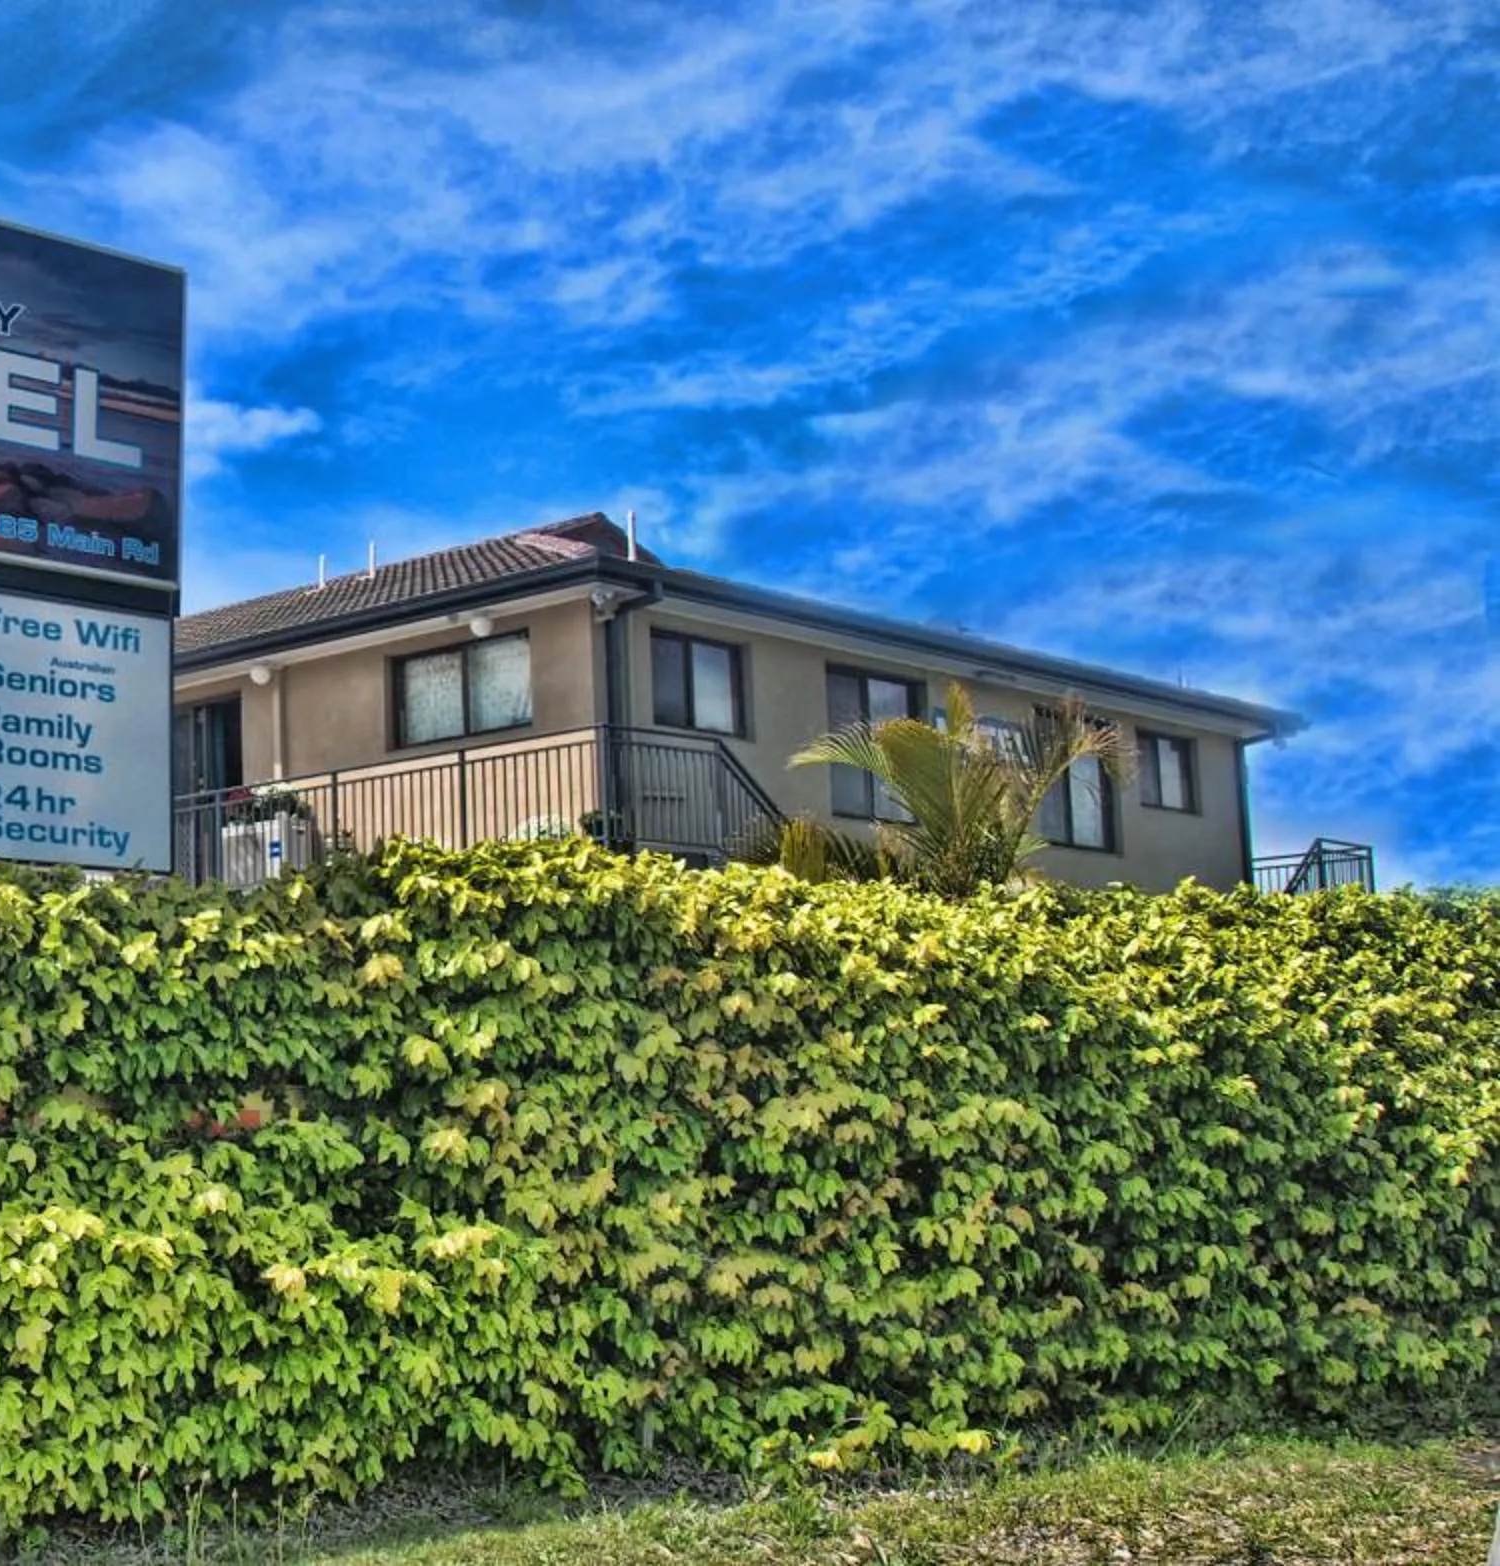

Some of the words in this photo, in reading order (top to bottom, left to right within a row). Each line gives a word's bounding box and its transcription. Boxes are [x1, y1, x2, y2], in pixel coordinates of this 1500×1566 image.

[47, 522, 115, 557] Main
[121, 537, 159, 565] Rd
[74, 619, 141, 653] Wifi
[50, 656, 115, 675] Australian
